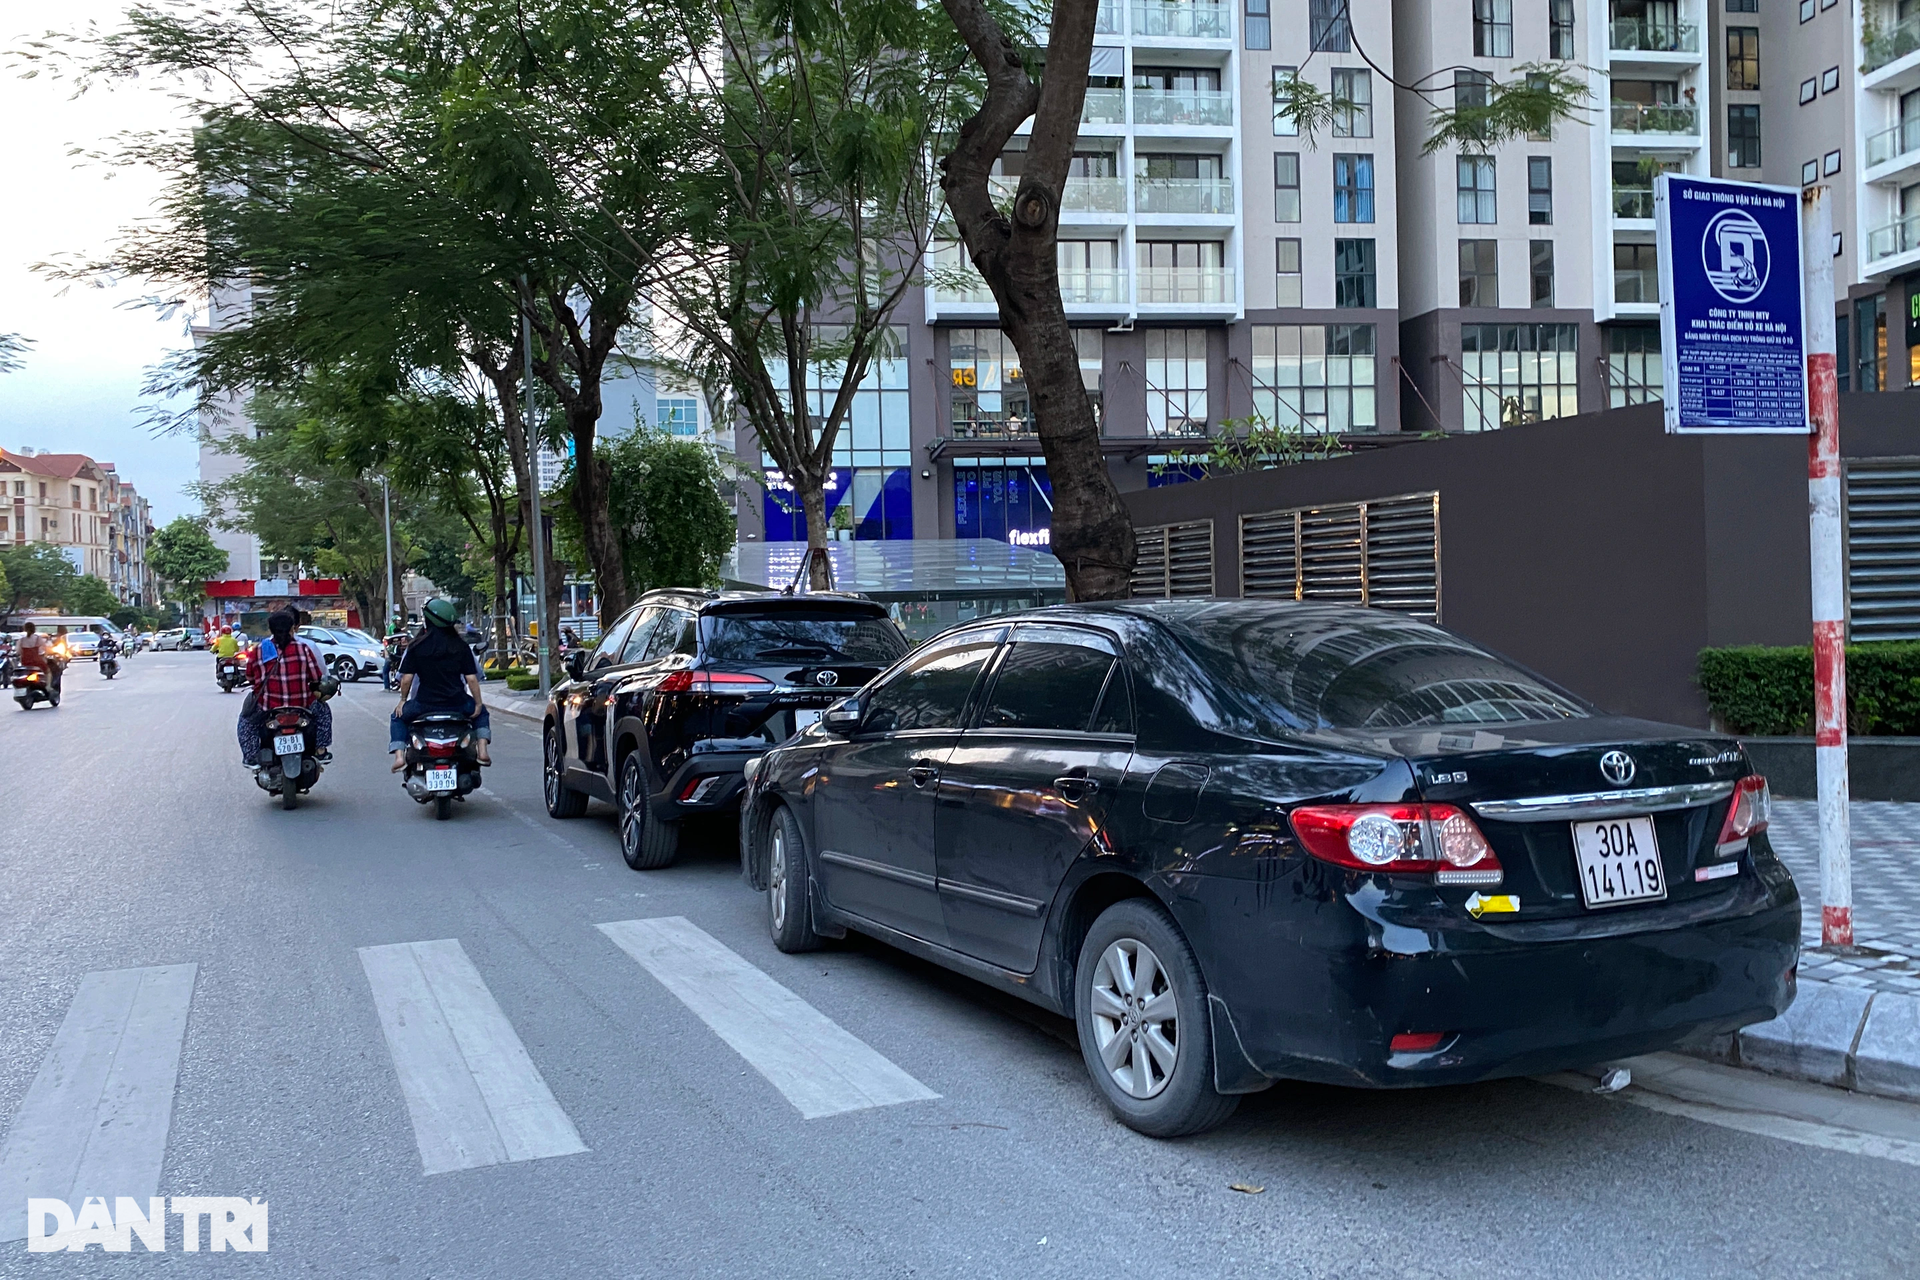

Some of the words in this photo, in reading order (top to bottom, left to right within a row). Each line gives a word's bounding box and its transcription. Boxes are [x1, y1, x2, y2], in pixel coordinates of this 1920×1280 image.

[1683, 188, 1692, 199] SỞ
[1694, 191, 1710, 201] GIAO
[1712, 193, 1734, 203] THÔNG
[1774, 197, 1785, 209] NỘI
[1709, 308, 1727, 318] CÔNG
[1728, 310, 1736, 318] TY
[1756, 312, 1769, 320] MTV
[1692, 320, 1707, 328] KHAI
[1709, 320, 1725, 329] THÁC
[1755, 323, 1763, 331] XE
[1596, 822, 1638, 858] 30A
[1589, 859, 1659, 899] 141.19
